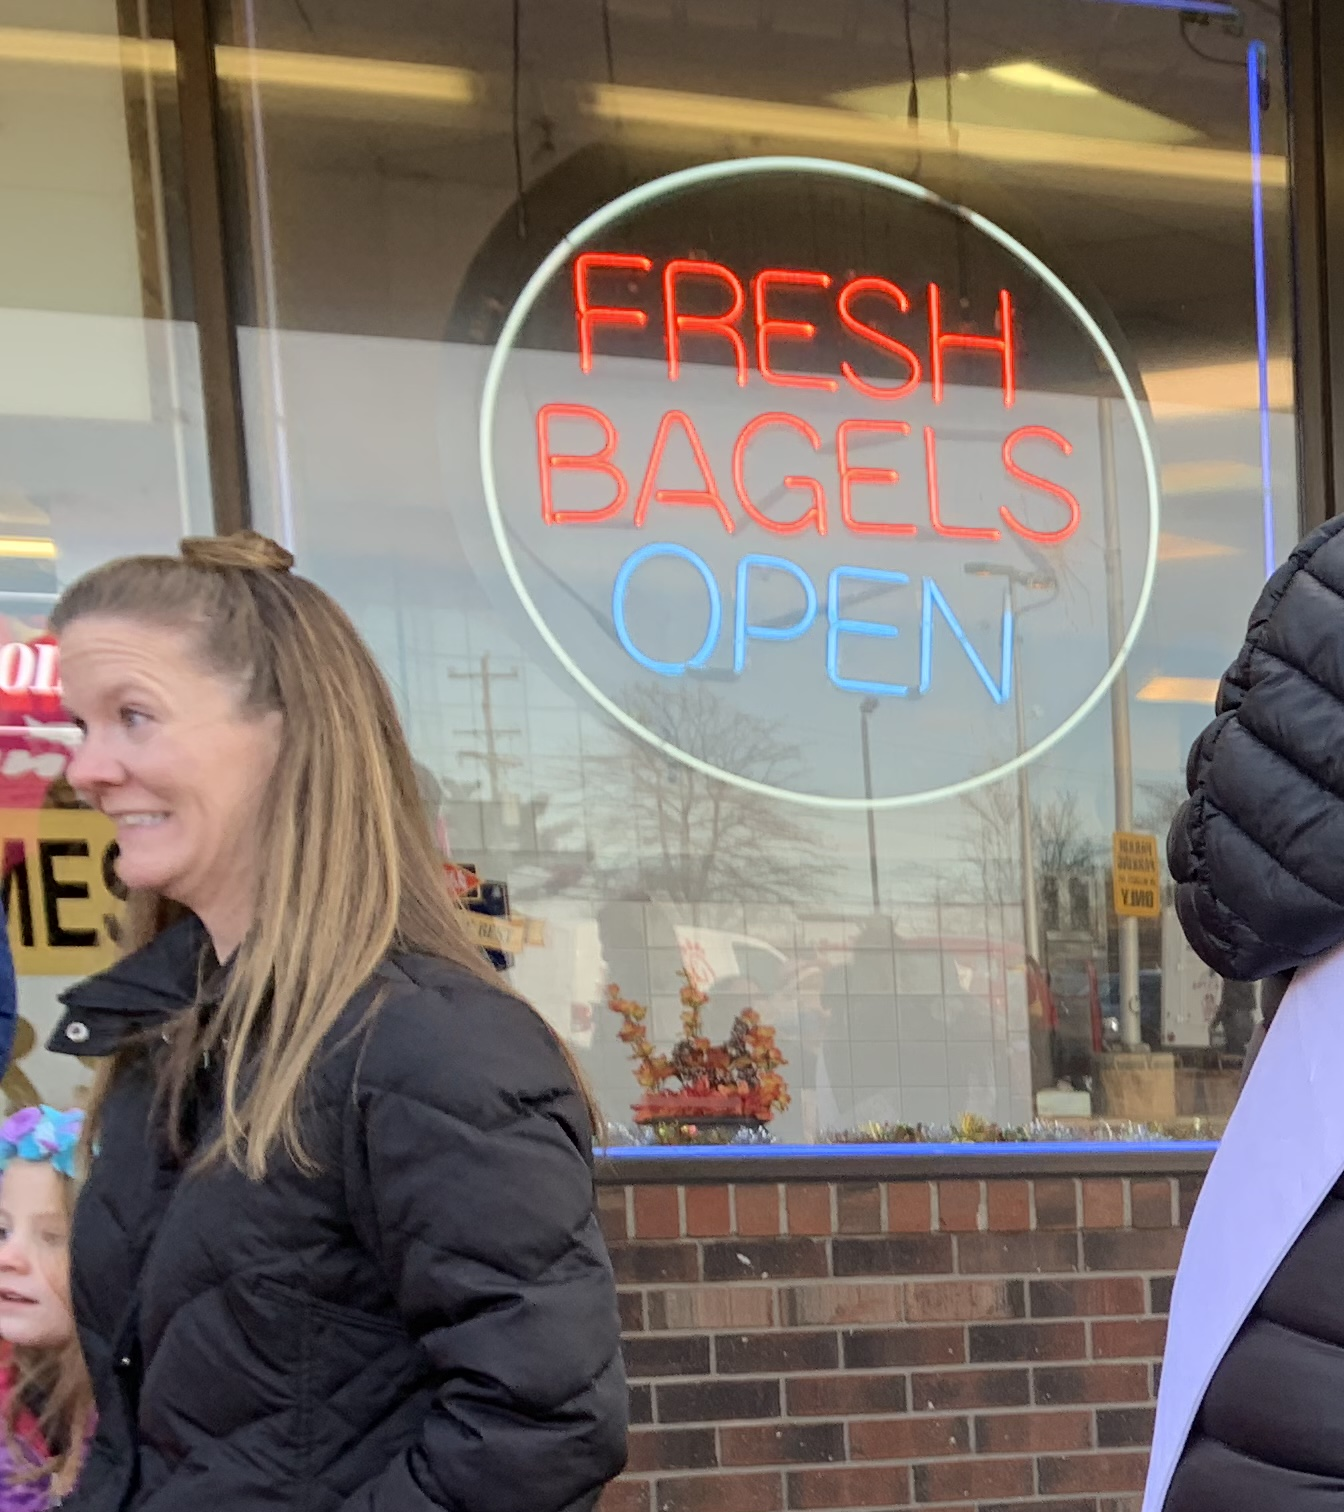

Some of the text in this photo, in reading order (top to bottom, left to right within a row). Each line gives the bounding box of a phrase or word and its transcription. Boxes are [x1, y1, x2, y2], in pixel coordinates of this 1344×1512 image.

[573, 251, 1016, 408] FRESH
[536, 403, 1081, 543] BAGELS
[612, 541, 1013, 705] OPEN
